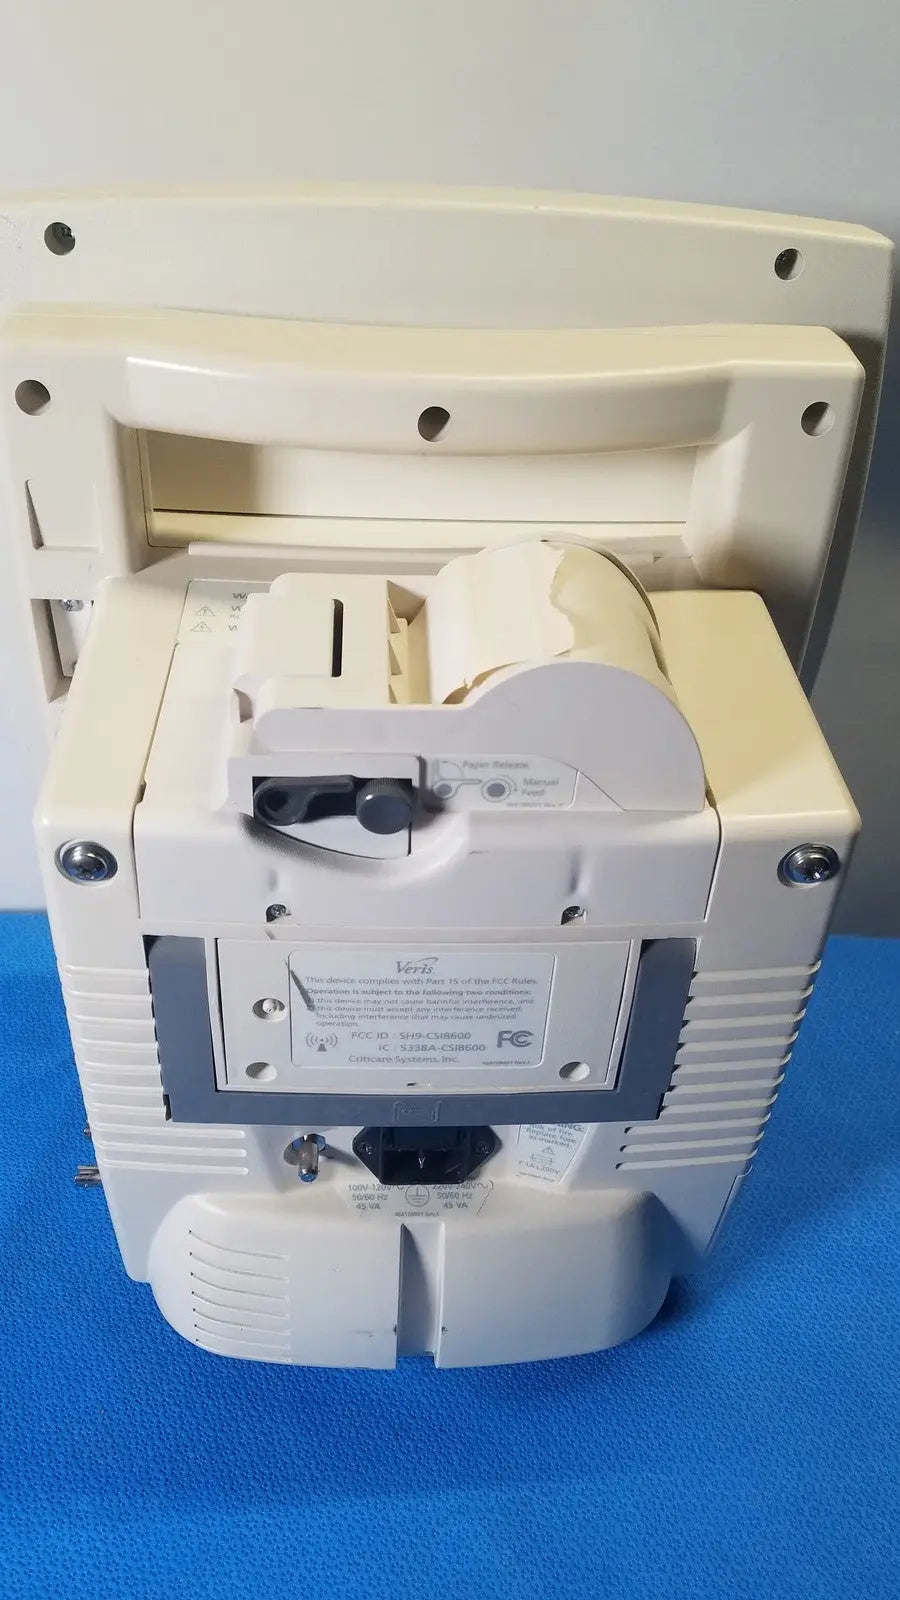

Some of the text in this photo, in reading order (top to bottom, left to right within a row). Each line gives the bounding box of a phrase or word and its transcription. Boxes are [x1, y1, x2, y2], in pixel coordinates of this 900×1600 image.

[462, 760, 530, 770] Paper Release
[523, 778, 559, 786] Manual
[521, 788, 545, 797] Feed
[305, 976, 324, 984] This
[326, 976, 356, 984] device
[358, 978, 400, 986] complies
[362, 989, 392, 997] subject
[423, 989, 464, 997] following
[400, 1032, 472, 1040] SH9-CSI8600
[526, 1128, 557, 1140] Replace
[352, 1193, 375, 1201] 50/60
[436, 1192, 460, 1200] 50/60
